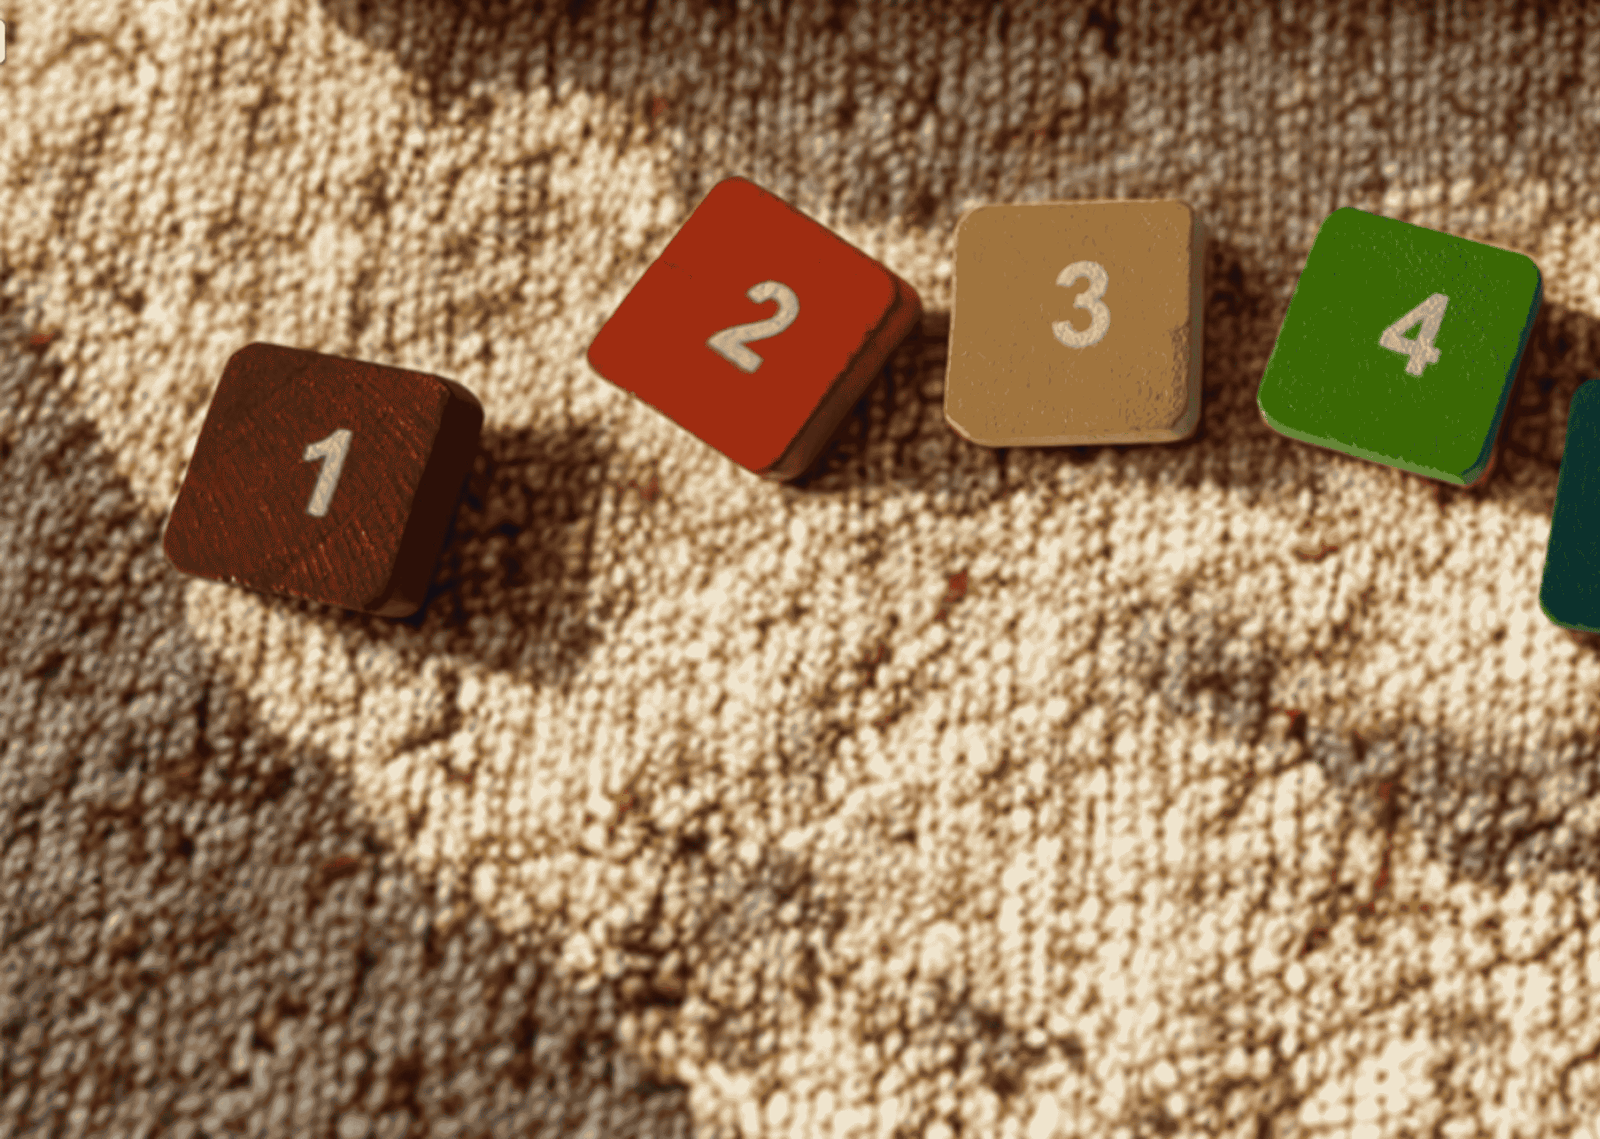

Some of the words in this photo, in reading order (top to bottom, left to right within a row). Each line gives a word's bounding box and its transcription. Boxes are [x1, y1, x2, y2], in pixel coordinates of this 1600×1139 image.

[708, 281, 799, 372] 2
[1050, 259, 1111, 350] 3
[1379, 293, 1449, 376] 4
[304, 429, 352, 517] 1
